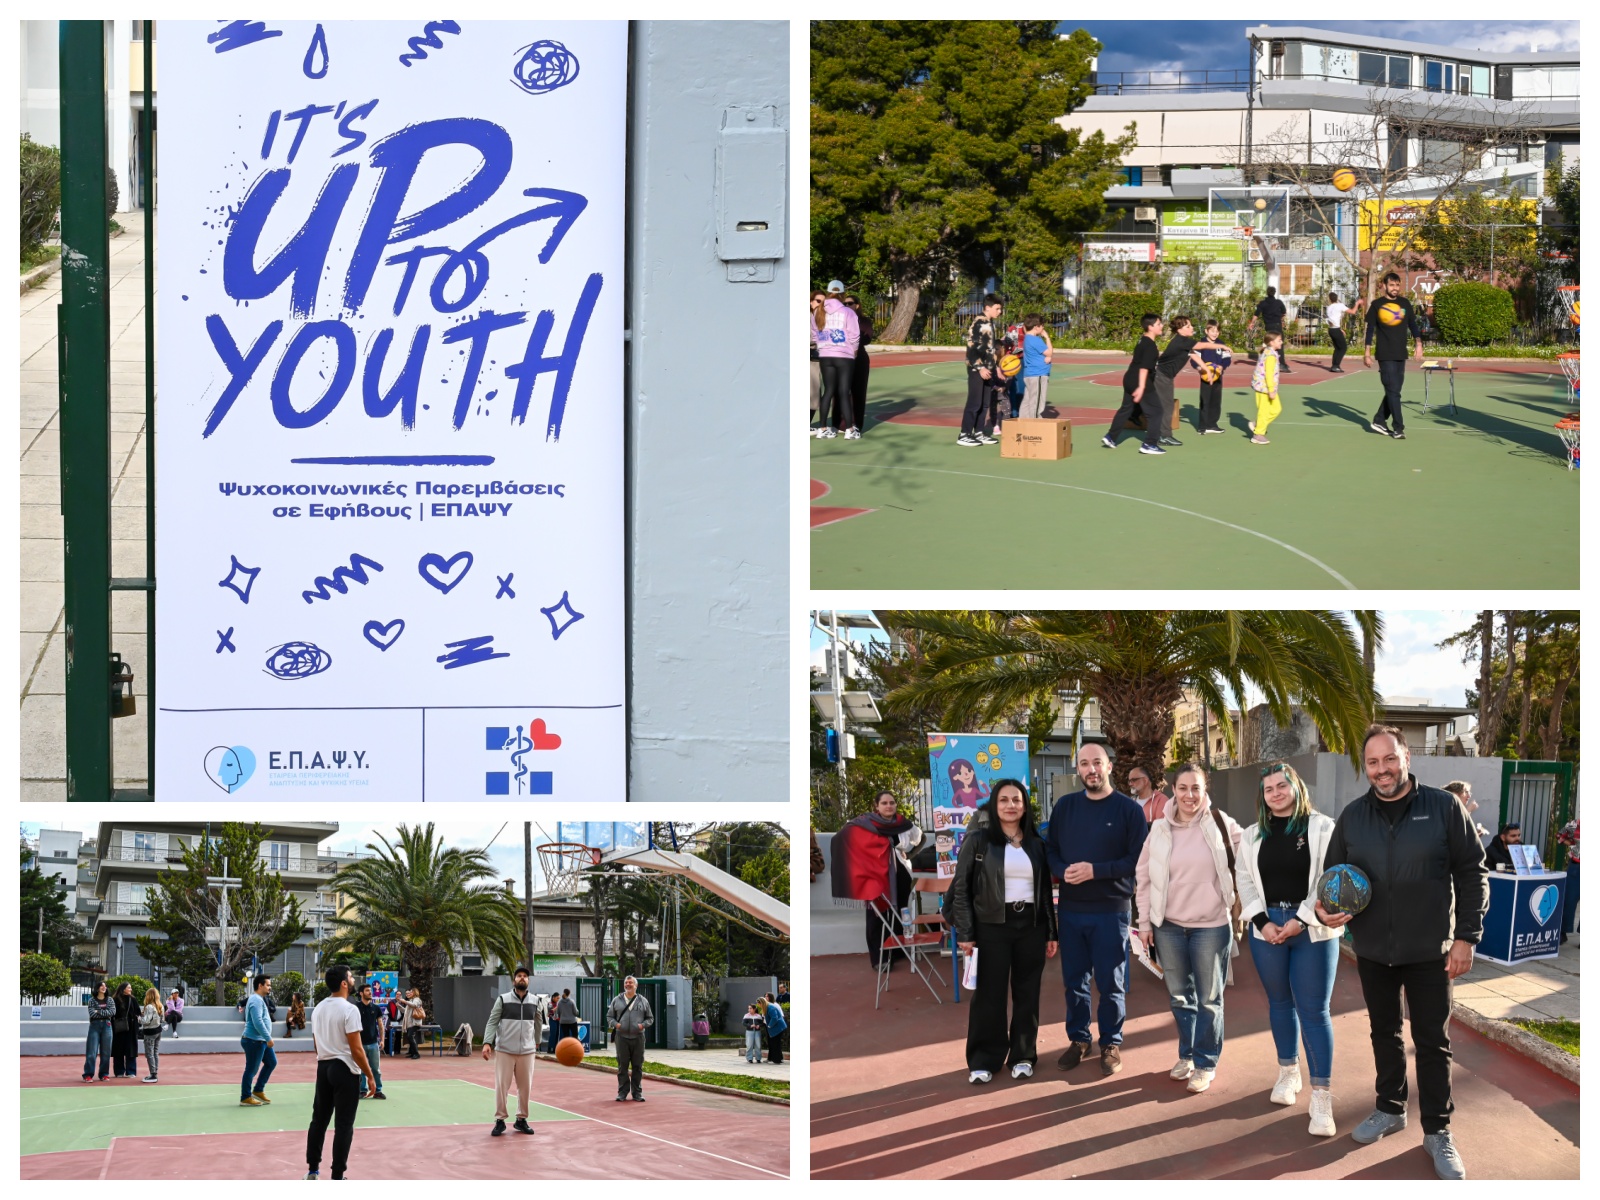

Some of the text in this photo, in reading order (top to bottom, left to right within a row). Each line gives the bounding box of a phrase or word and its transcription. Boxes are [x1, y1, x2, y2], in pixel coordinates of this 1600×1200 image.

[261, 98, 378, 161] IT'S
[224, 117, 513, 319] UP
[386, 246, 490, 317] TO
[202, 272, 603, 442] YOUTH
[218, 480, 566, 499] Ψυχοκοινωνικές Παρεμβάσεις
[272, 506, 302, 518] σε
[309, 503, 412, 521] Εφήβους
[431, 503, 514, 517] ΕΠΑΨΥ
[269, 750, 370, 770] Ε.Π.Α.Ψ.Υ.
[933, 811, 972, 828] ΕΚΠΑ
[1516, 929, 1558, 946] Ε.Π.Α.Ψ.Υ.
